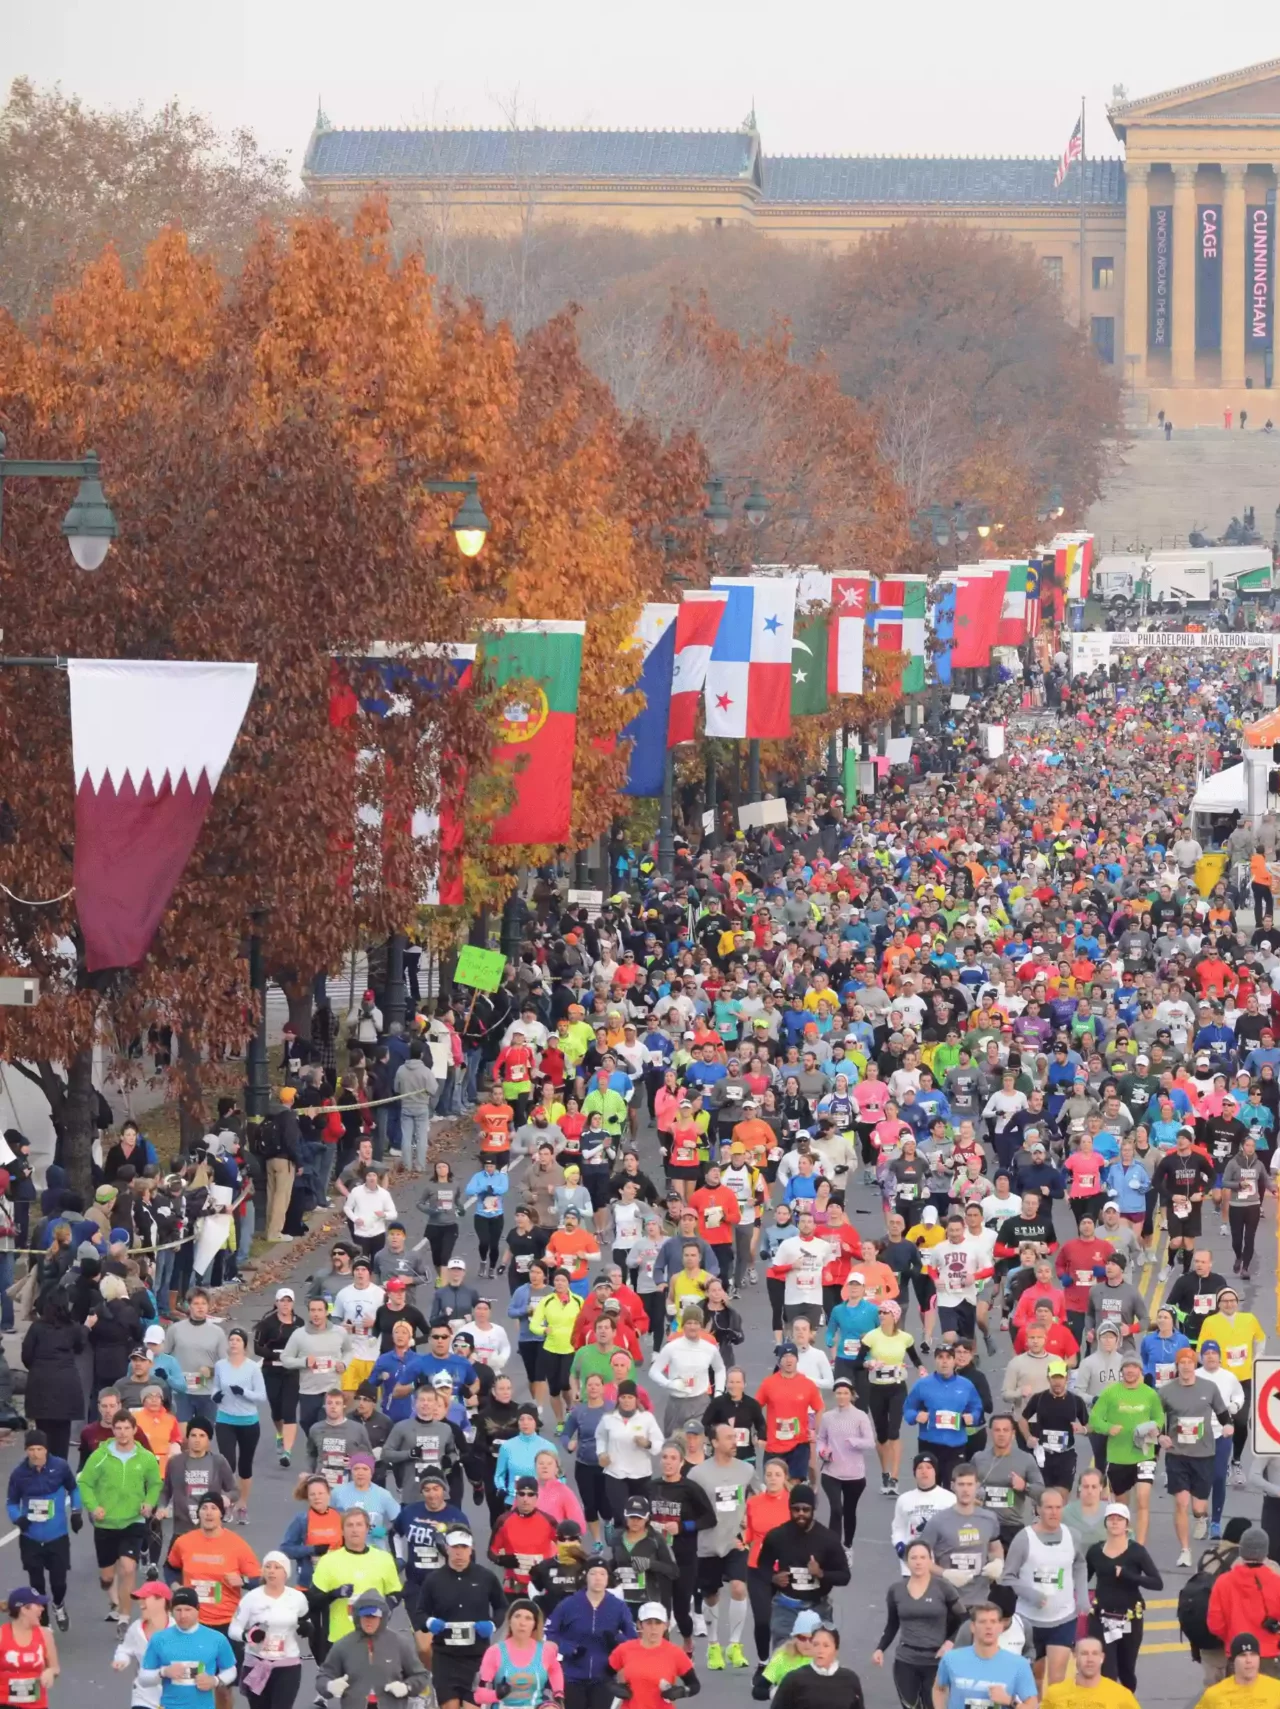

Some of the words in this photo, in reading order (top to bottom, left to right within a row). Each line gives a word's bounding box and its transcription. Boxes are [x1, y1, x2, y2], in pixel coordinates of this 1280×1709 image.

[1202, 209, 1217, 258] CAGE
[1252, 209, 1268, 337] CUNNINGHAM
[1137, 633, 1195, 646] PHILADELPHIA
[1201, 633, 1246, 647] MARATHON
[487, 1117, 506, 1126] VT
[1014, 1226, 1045, 1235] STHM
[944, 1252, 967, 1266] FDU
